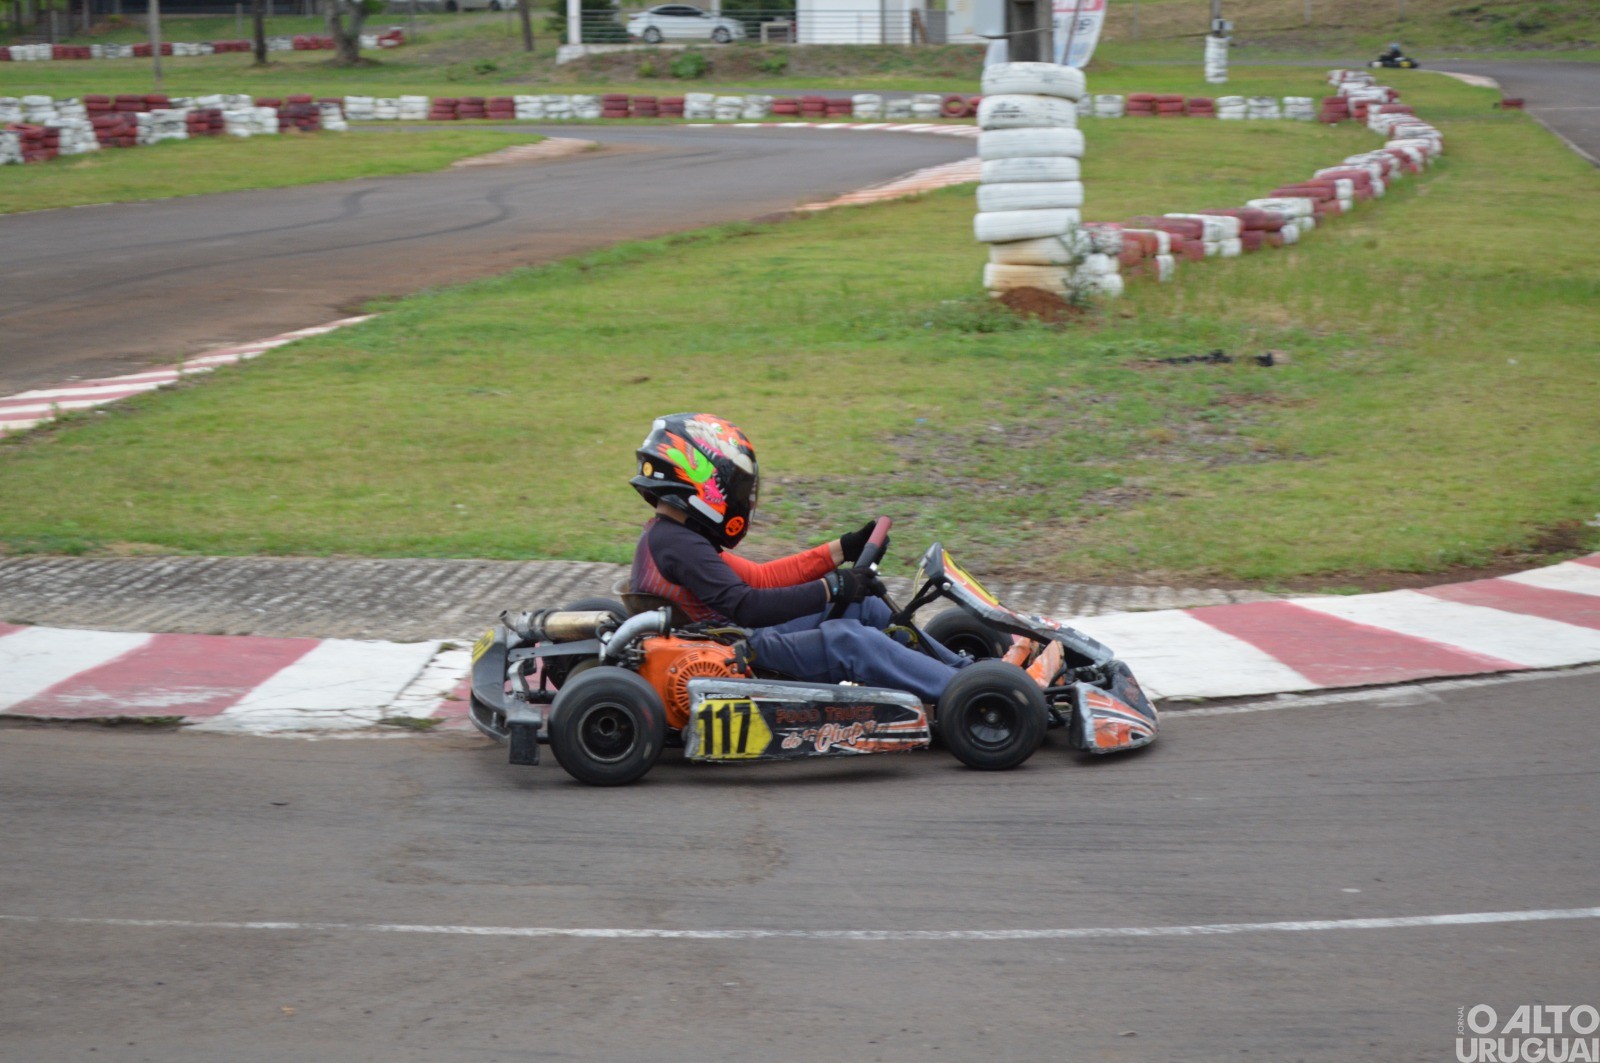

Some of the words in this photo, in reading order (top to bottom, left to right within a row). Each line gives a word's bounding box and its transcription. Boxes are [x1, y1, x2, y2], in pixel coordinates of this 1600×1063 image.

[698, 703, 751, 756] 117
[775, 708, 819, 723] FOOD
[824, 705, 876, 721] TRUCK
